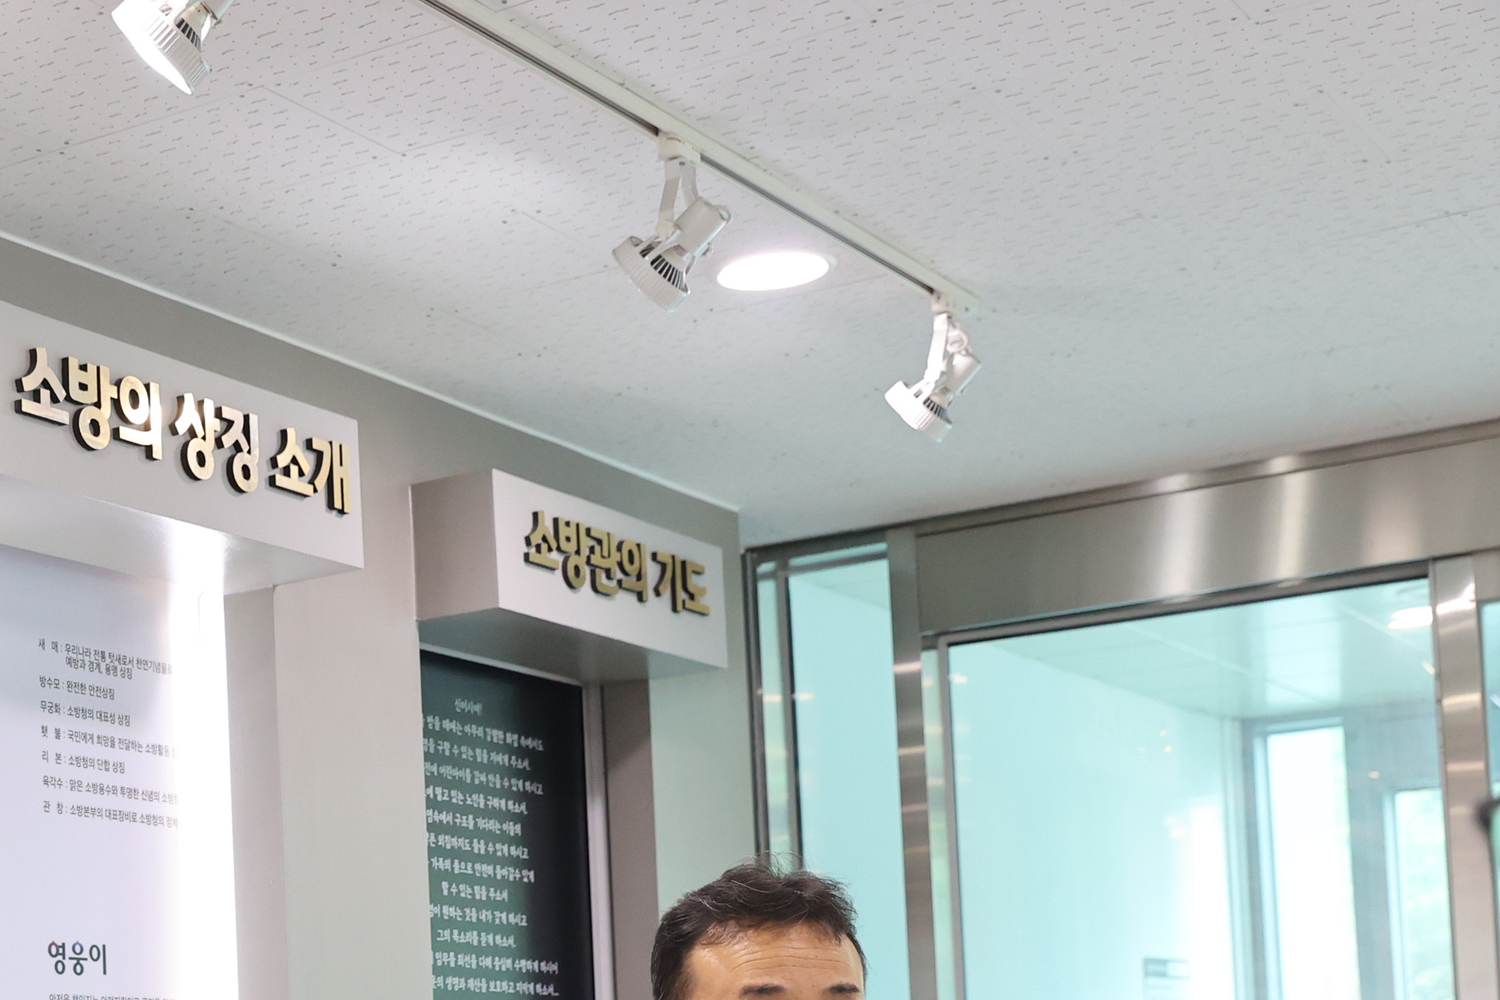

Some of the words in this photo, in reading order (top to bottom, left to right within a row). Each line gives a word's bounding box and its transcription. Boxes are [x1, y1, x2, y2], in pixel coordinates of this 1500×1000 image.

[15, 347, 162, 460] 소방의
[171, 392, 258, 493] 상징
[269, 427, 350, 514] 소개
[524, 510, 648, 603] 소방관의
[652, 552, 710, 616] 기도
[48, 941, 107, 976] 영웅이
